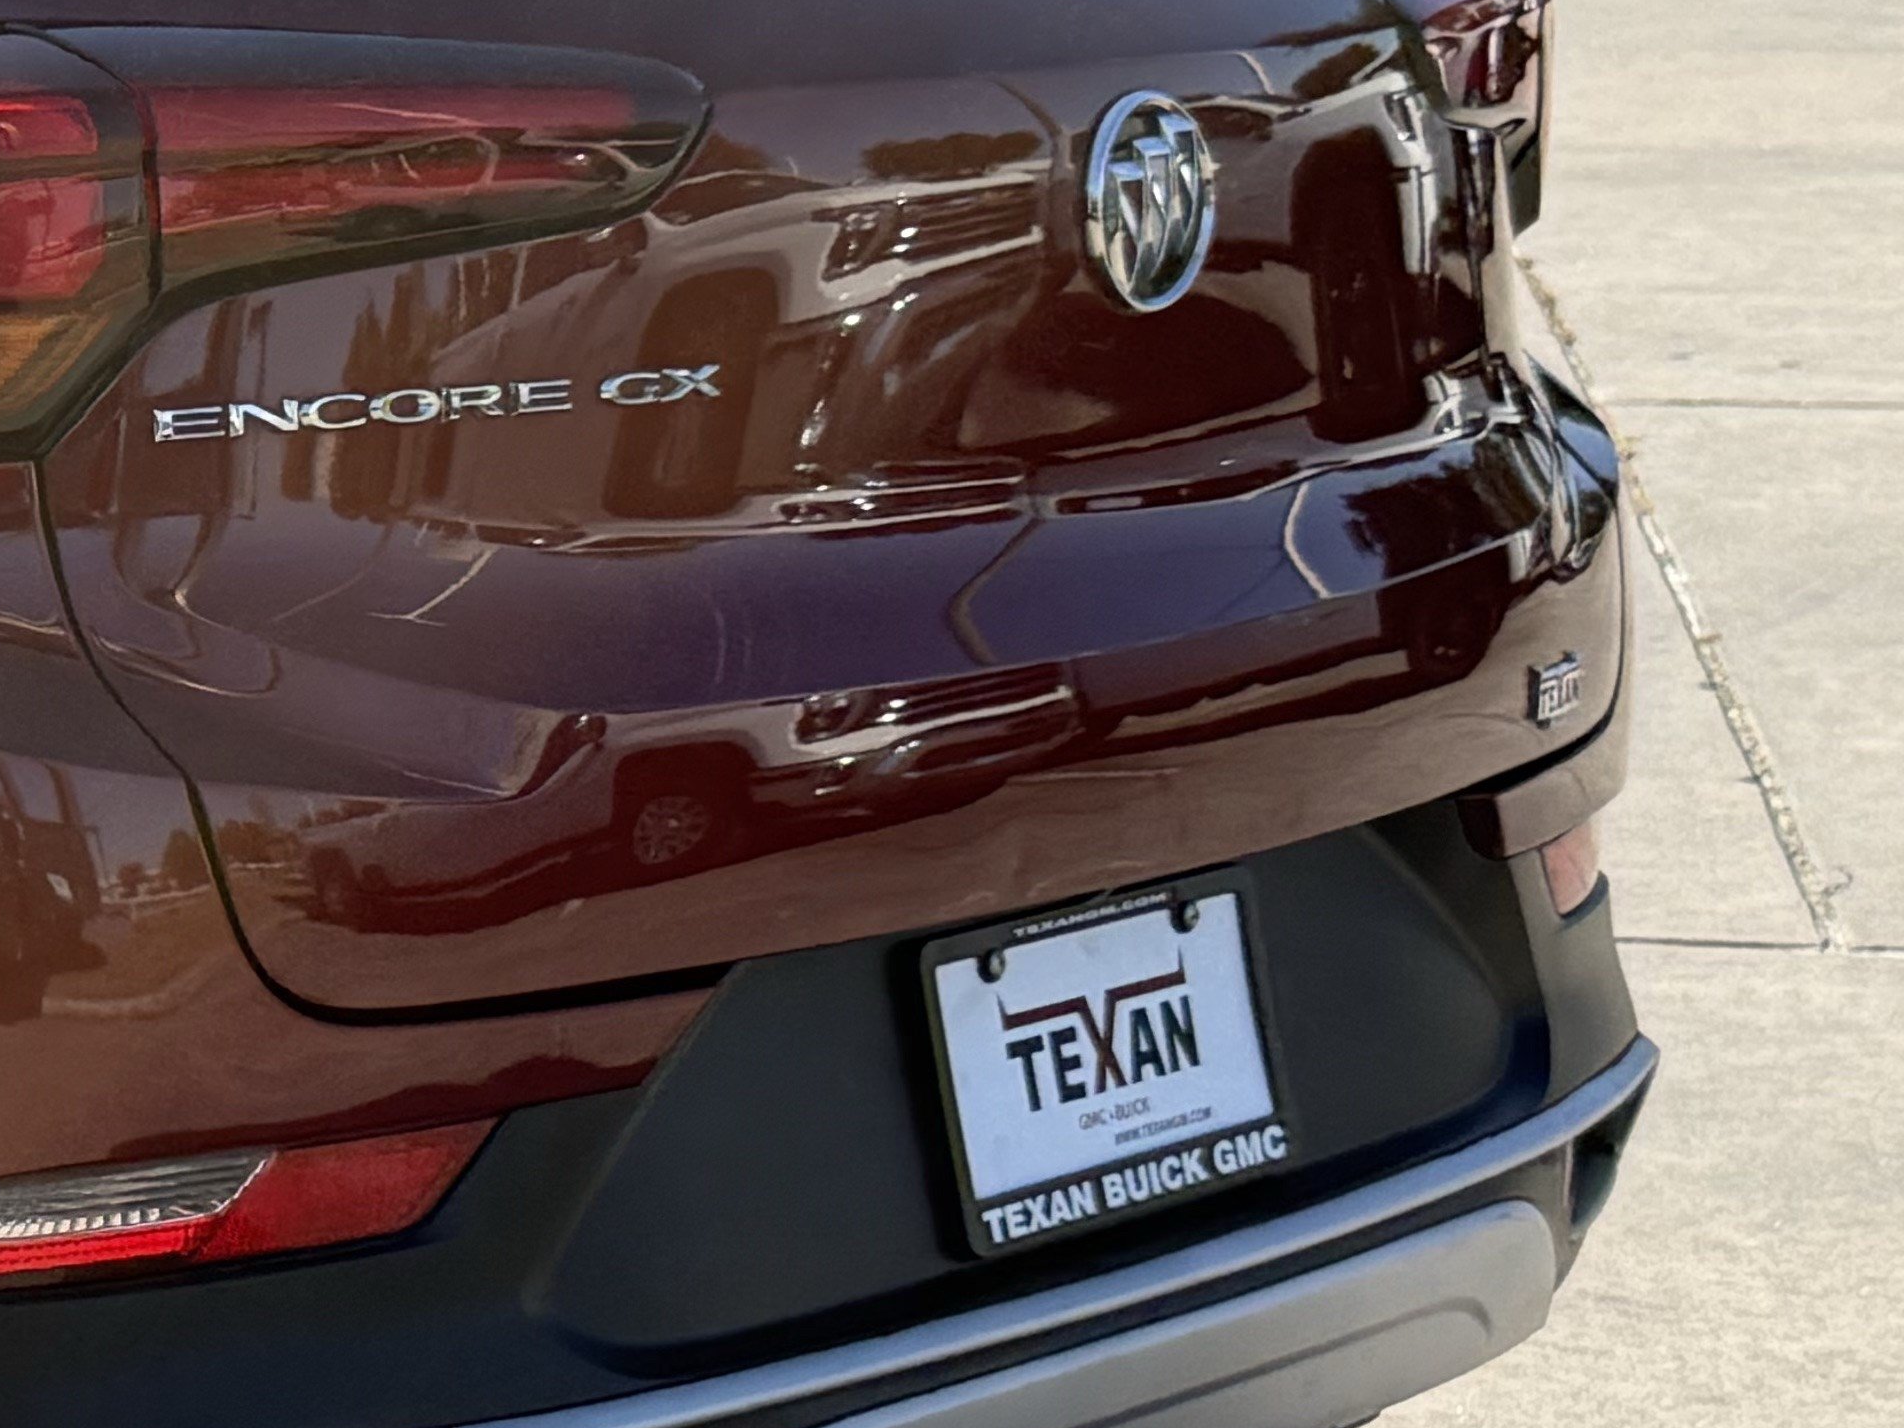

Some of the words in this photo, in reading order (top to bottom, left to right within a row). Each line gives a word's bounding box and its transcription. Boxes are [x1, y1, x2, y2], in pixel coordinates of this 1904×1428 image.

[153, 378, 573, 443] ENCORE
[599, 363, 721, 406] GX
[1012, 891, 1169, 938] TEXANGM.COM
[998, 984, 1202, 1112] TEXAN
[980, 1180, 1100, 1245] TEXAN
[1101, 1146, 1211, 1209] BUICK
[1212, 1123, 1288, 1175] GMC
